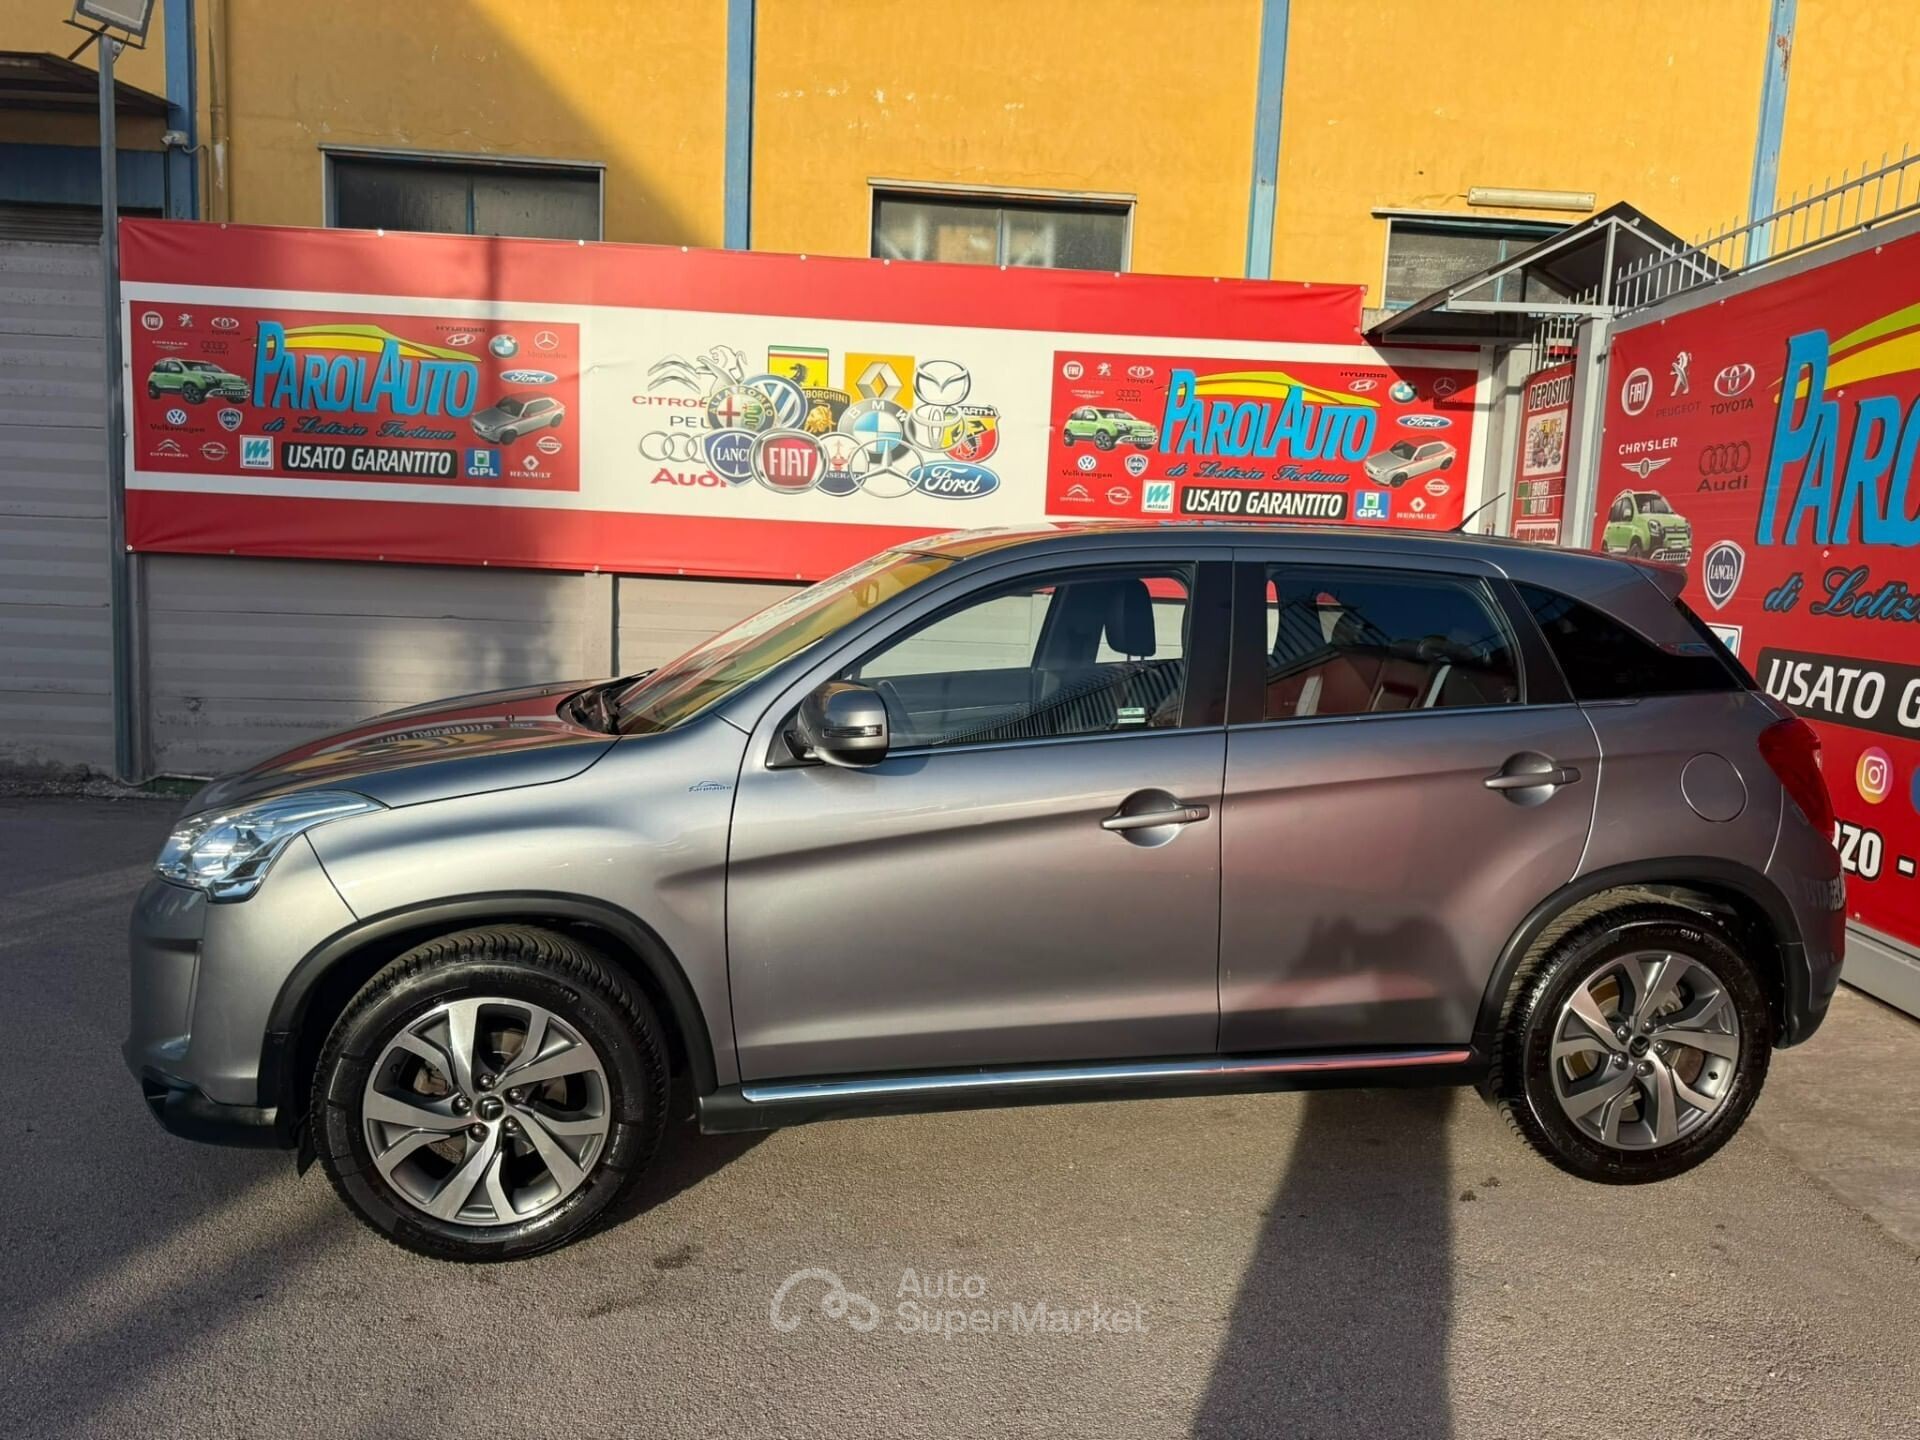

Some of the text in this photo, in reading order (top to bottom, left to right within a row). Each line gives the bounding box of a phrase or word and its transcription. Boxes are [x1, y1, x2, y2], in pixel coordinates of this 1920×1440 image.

[511, 371, 546, 383] Ford
[1340, 371, 1388, 379] HYUNDAI
[803, 389, 849, 405] BORGHINI
[1529, 375, 1574, 412] DEPOSITO
[1629, 381, 1648, 405] FIAT
[1656, 401, 1702, 418] PEUGEOT
[1710, 398, 1754, 417] TOYOTA
[263, 415, 457, 440] di Letizia Fortuna
[1407, 416, 1441, 428] Ford
[1619, 437, 1678, 455] CHRYSLER
[287, 444, 452, 475] USATO GARANTITO
[768, 446, 813, 477] FIAT
[468, 466, 498, 477] GPL
[510, 470, 553, 479] RENAULT
[924, 464, 983, 493] Ford
[1166, 461, 1350, 484] di Letizia Fortuna
[1696, 475, 1748, 492] Audi
[1185, 489, 1343, 517] USATO GARANTITO
[1357, 508, 1386, 518] GPL
[1710, 564, 1734, 580] LANCIA
[1764, 572, 1804, 613] di
[1765, 658, 1886, 720] USATO
